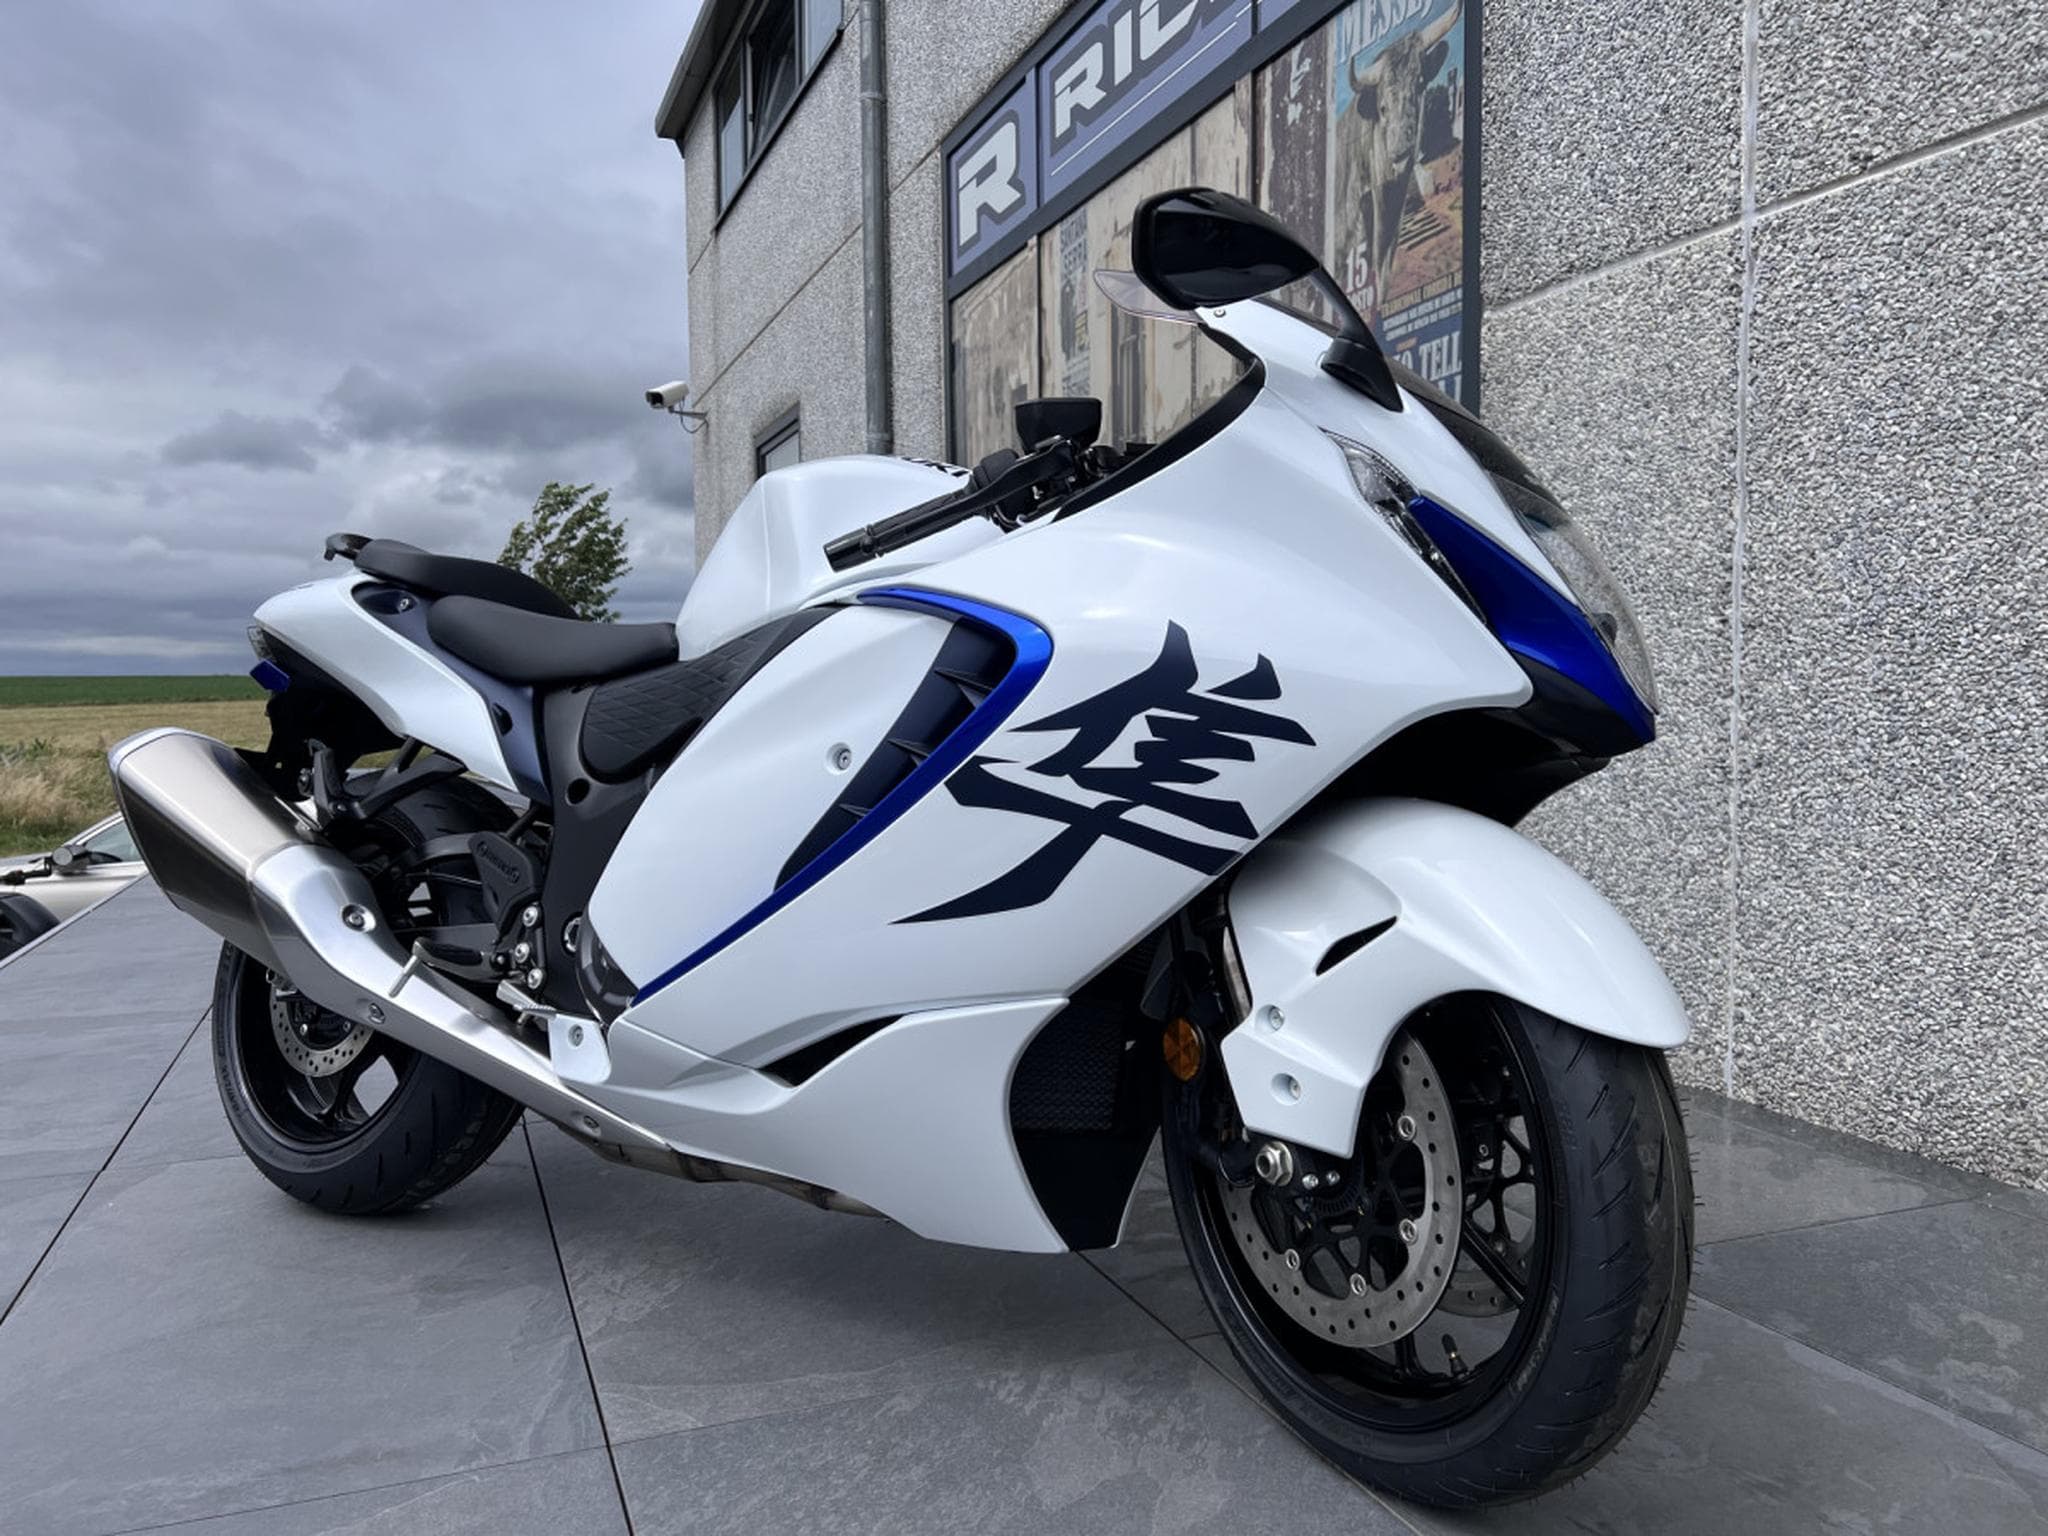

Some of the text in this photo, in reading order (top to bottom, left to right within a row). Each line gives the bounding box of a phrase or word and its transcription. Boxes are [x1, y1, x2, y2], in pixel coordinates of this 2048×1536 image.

[958, 121, 1022, 247] R
[1346, 242, 1368, 293] 15
[888, 619, 1317, 925] 隼
